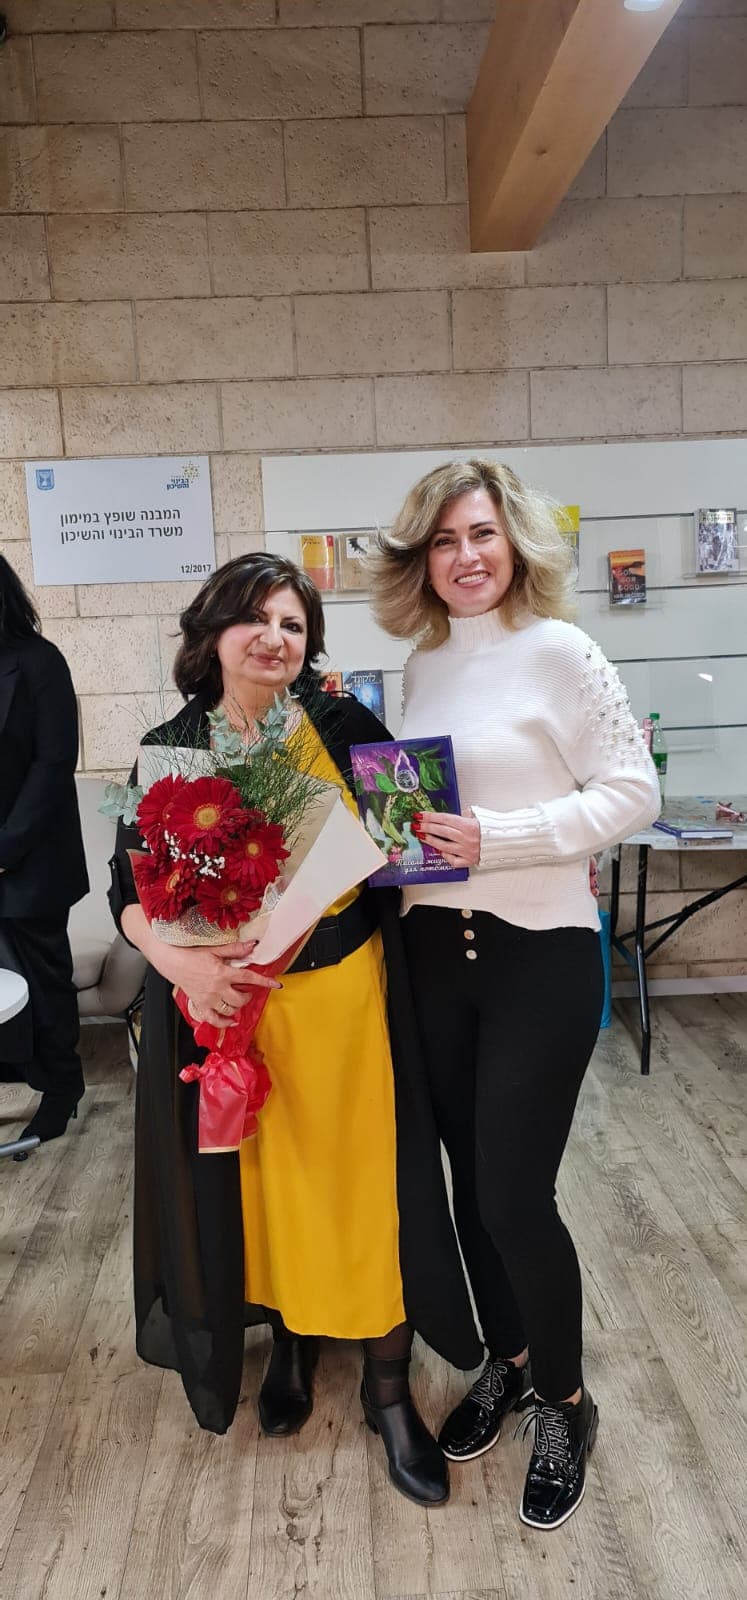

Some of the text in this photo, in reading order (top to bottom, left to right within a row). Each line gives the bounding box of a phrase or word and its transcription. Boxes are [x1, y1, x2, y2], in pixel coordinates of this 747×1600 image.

[60, 508, 181, 528] המבנה שופץ במימון
[60, 525, 183, 544] משרד הבינוי והשיכון
[181, 564, 211, 574] 12/2017
